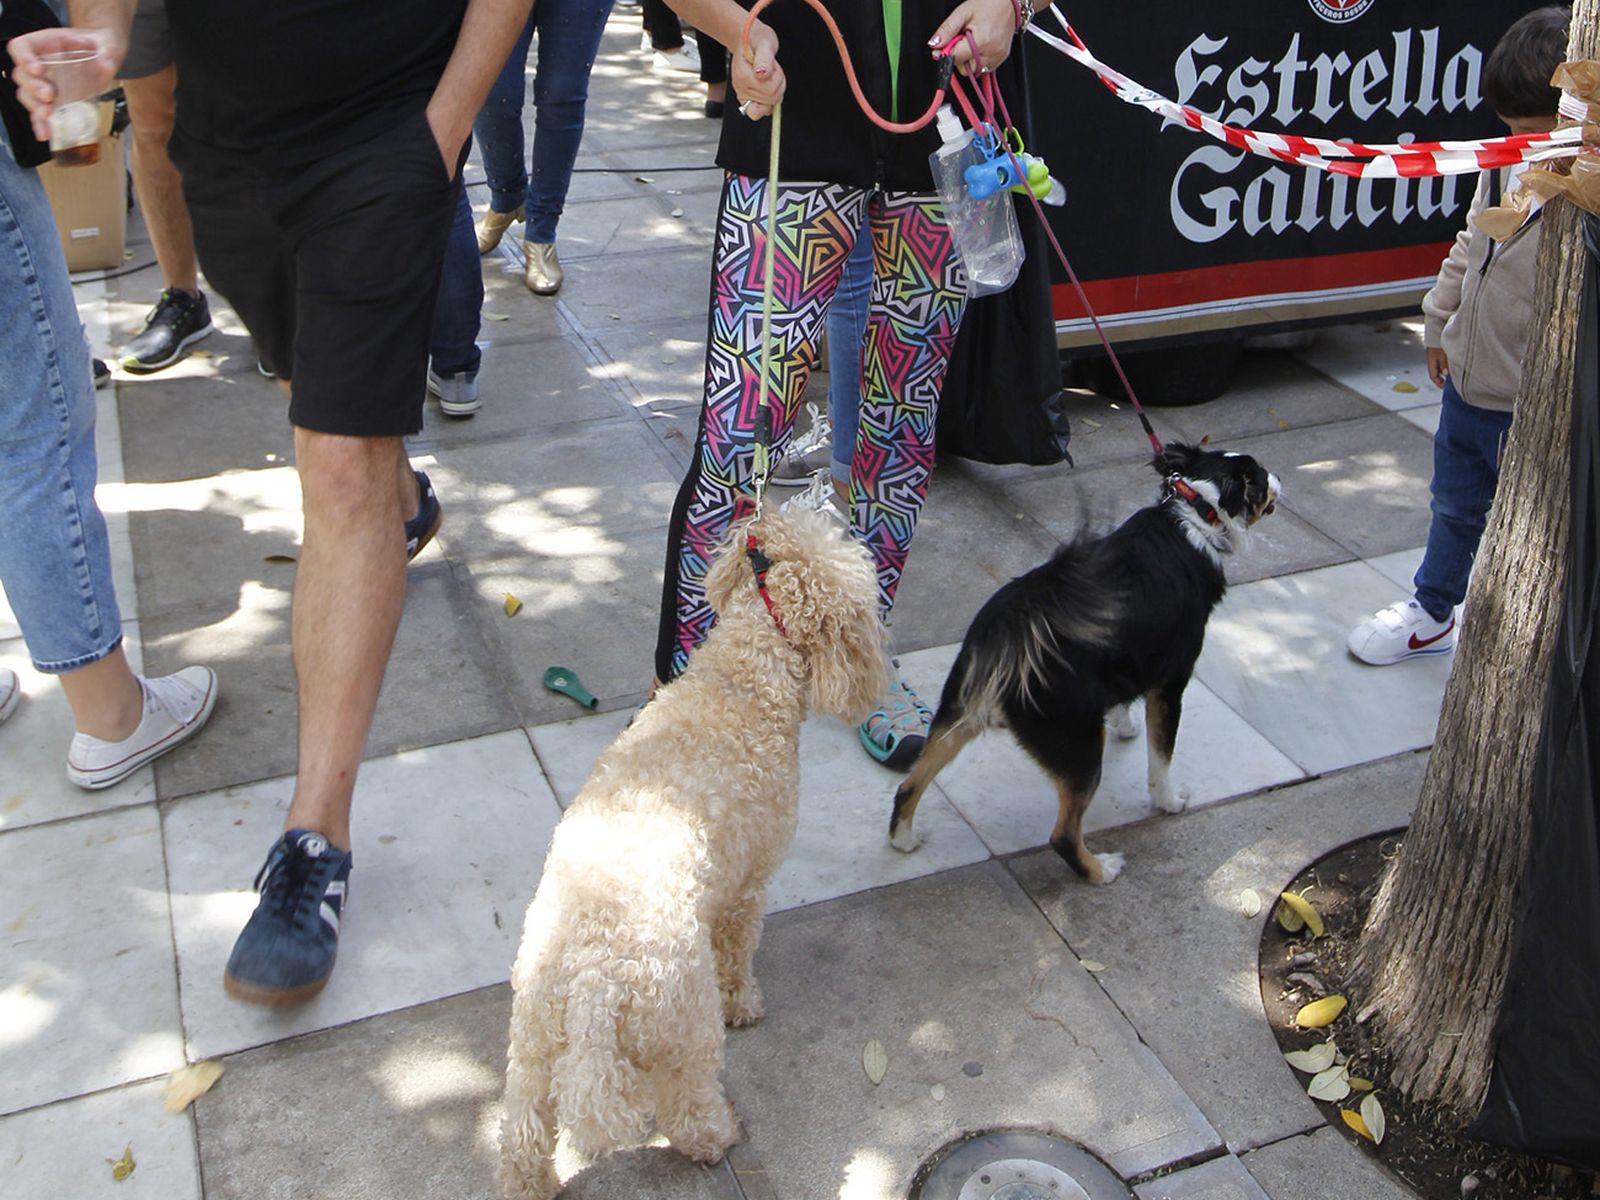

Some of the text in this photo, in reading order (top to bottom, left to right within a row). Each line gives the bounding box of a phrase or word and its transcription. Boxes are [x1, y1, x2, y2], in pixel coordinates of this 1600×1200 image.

[1343, 0, 1369, 18] DESDE
[1160, 26, 1485, 132] Estrella
[1170, 132, 1460, 244] Galicia
